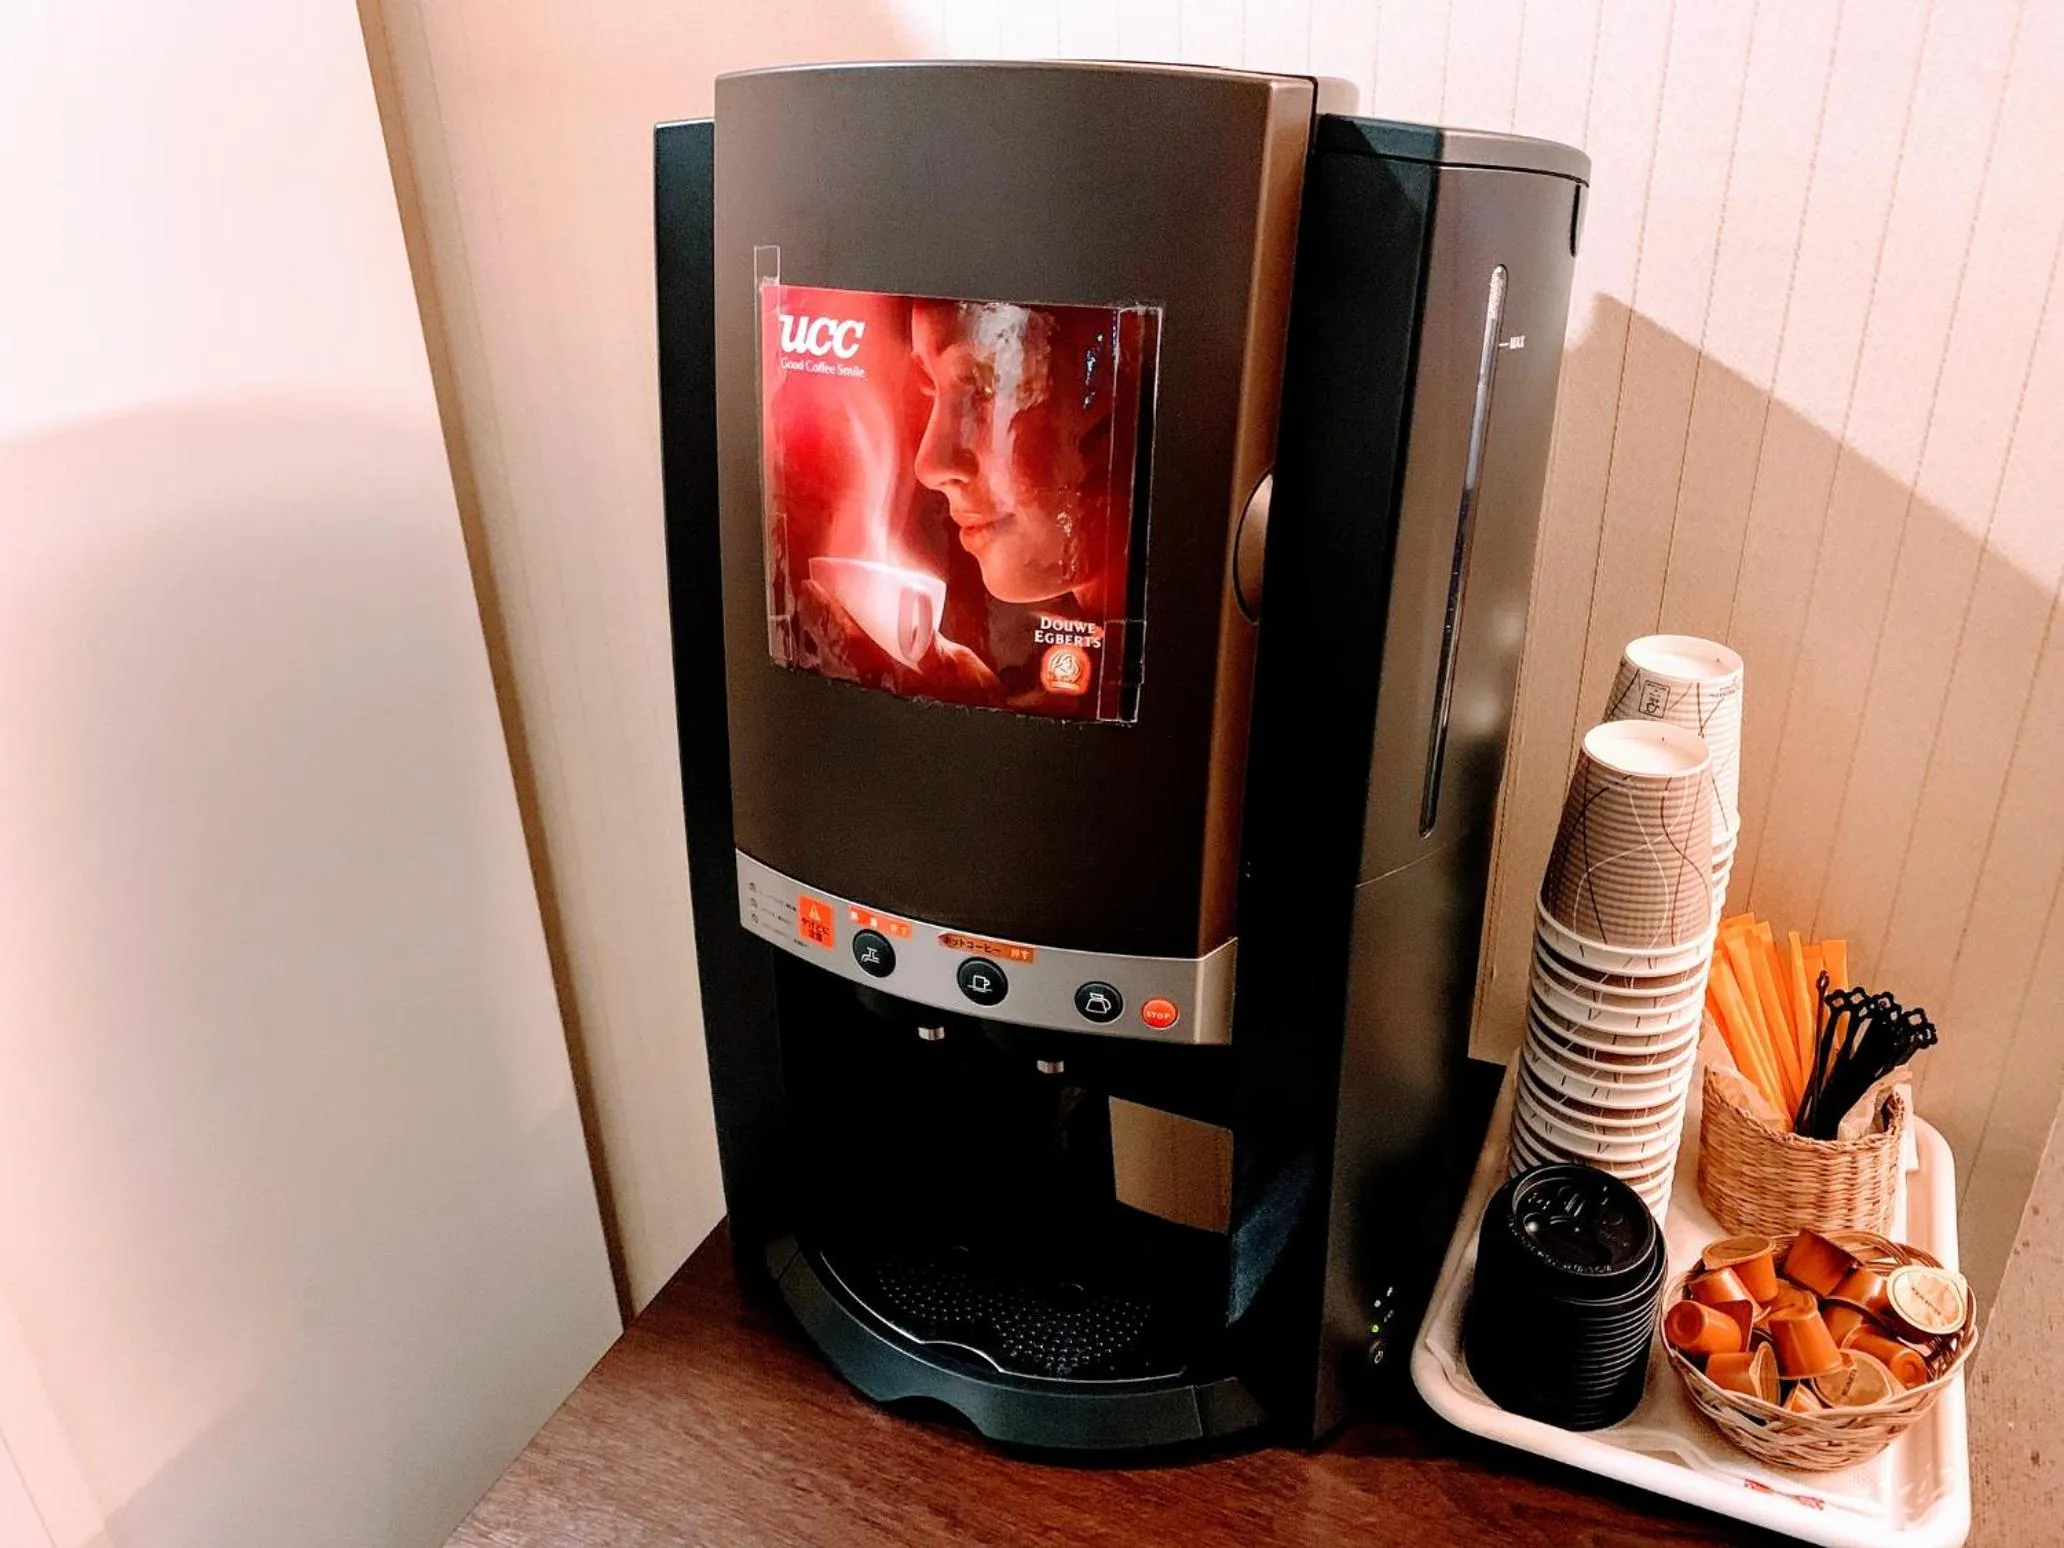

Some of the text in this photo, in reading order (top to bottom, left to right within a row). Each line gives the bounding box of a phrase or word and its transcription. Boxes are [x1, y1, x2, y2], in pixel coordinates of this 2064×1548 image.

[780, 357, 866, 379] Good Coffee Smile
[1040, 616, 1096, 634] DOUWE
[1034, 629, 1102, 649] EGBERTS
[1146, 1010, 1171, 1020] STOP
